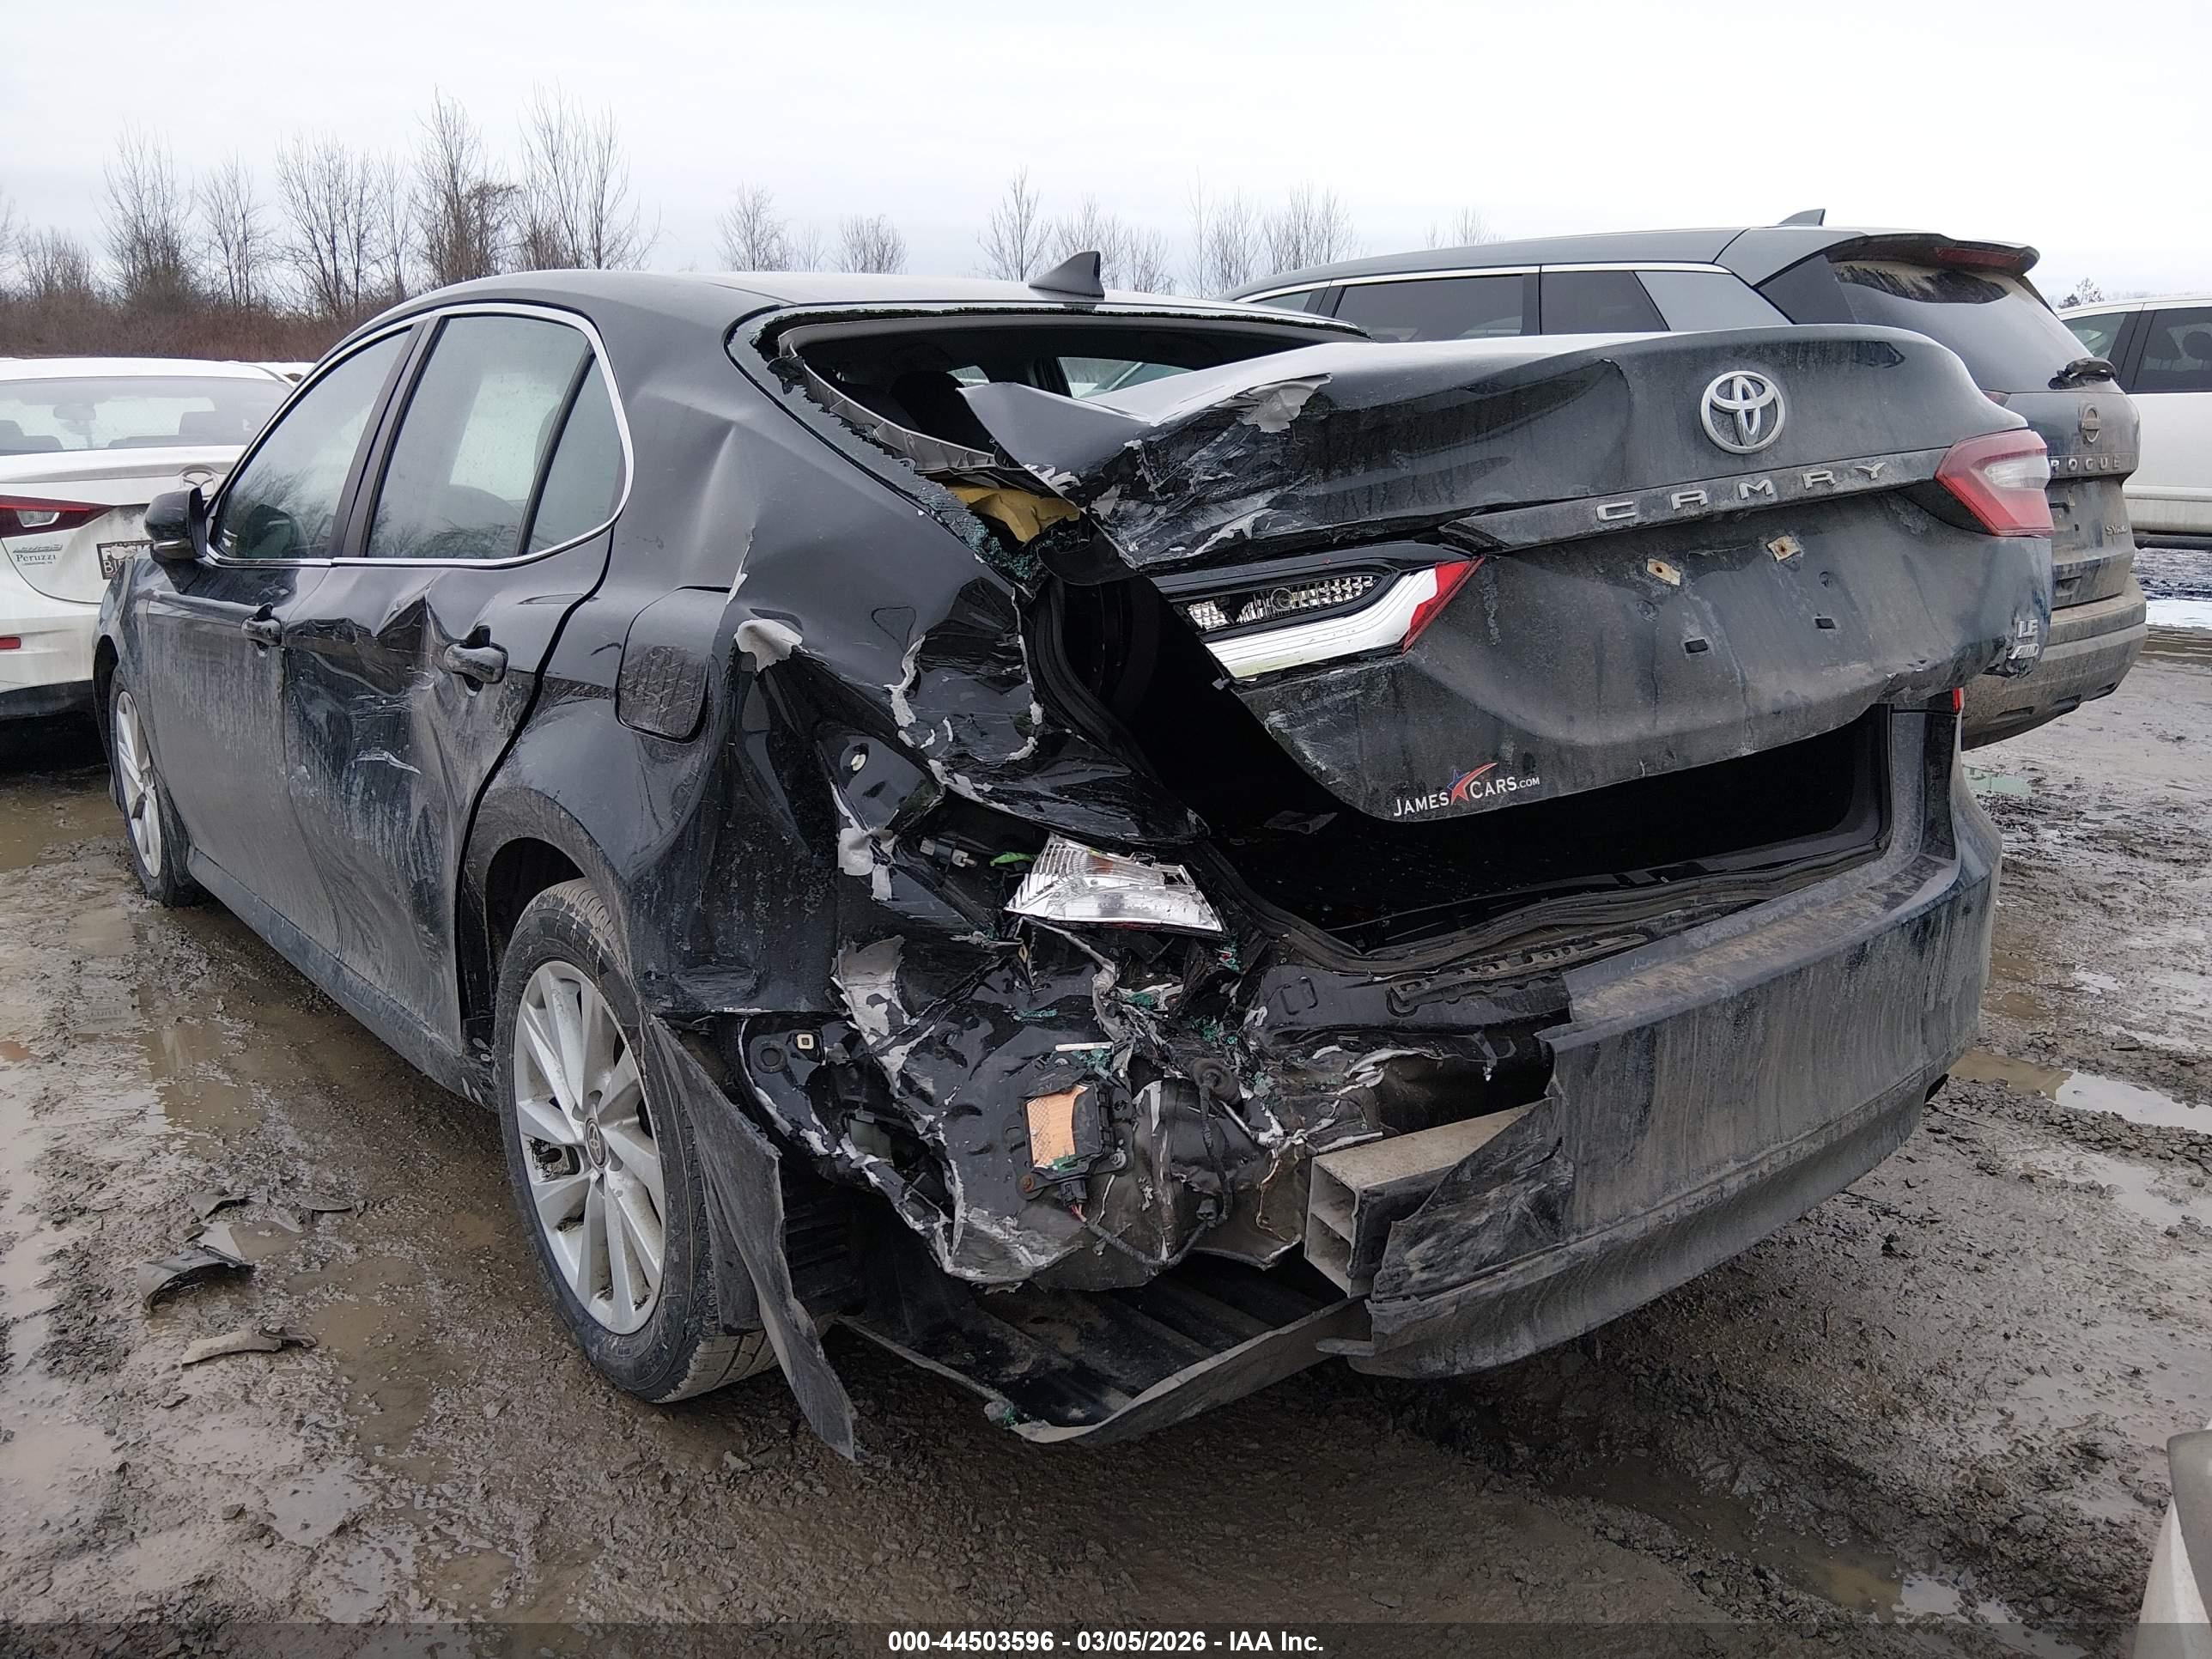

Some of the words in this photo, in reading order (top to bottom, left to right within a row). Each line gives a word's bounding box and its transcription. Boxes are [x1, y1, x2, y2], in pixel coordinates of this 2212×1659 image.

[2050, 456, 2121, 473] ROGUE
[1595, 461, 1887, 522] CAMRY
[16, 554, 57, 562] Peruzzi
[2016, 619, 2039, 639] LE
[1393, 791, 1450, 817] JAMES
